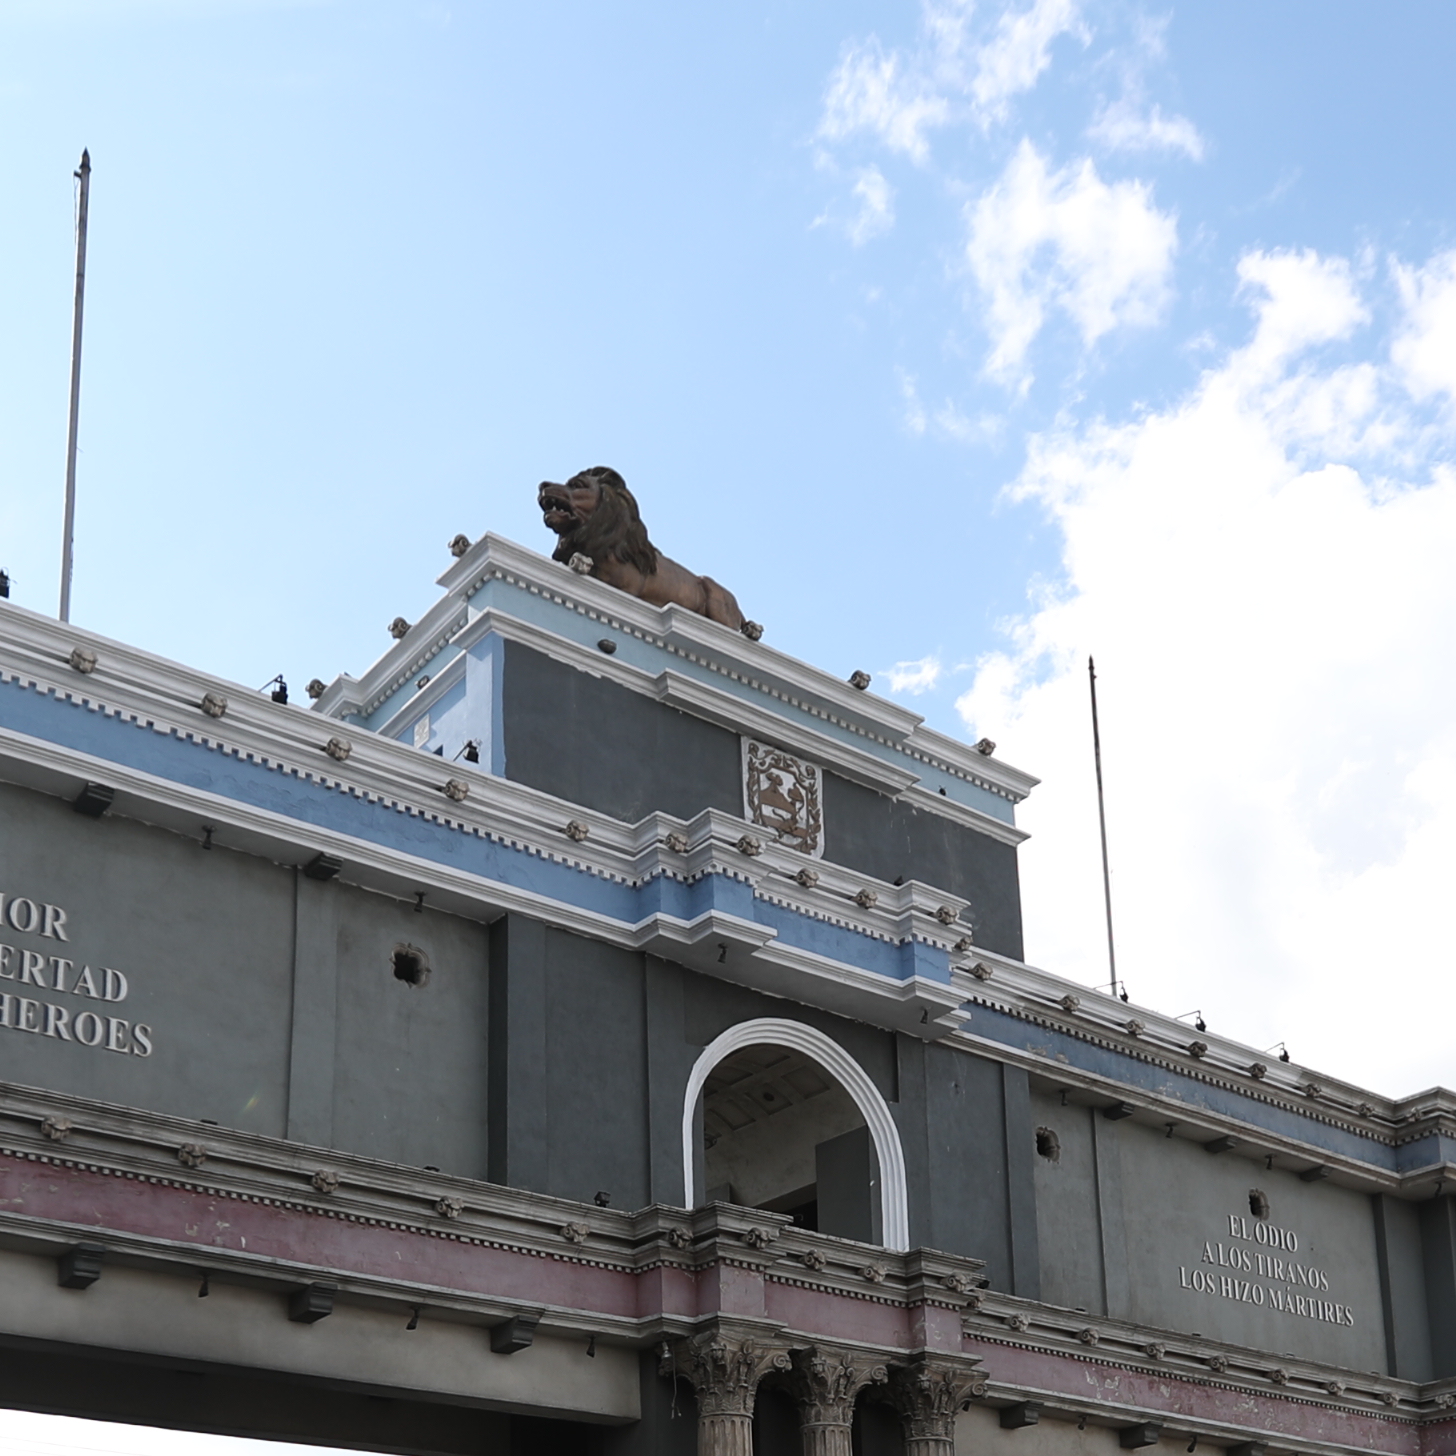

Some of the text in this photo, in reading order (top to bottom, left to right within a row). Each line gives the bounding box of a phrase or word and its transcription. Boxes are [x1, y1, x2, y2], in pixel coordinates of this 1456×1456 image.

[1228, 1214, 1299, 1253] EL ODIO
[1201, 1241, 1329, 1292] A LOS TIRANOS
[1179, 1266, 1354, 1328] LOS HIZO MÁRTIRES
